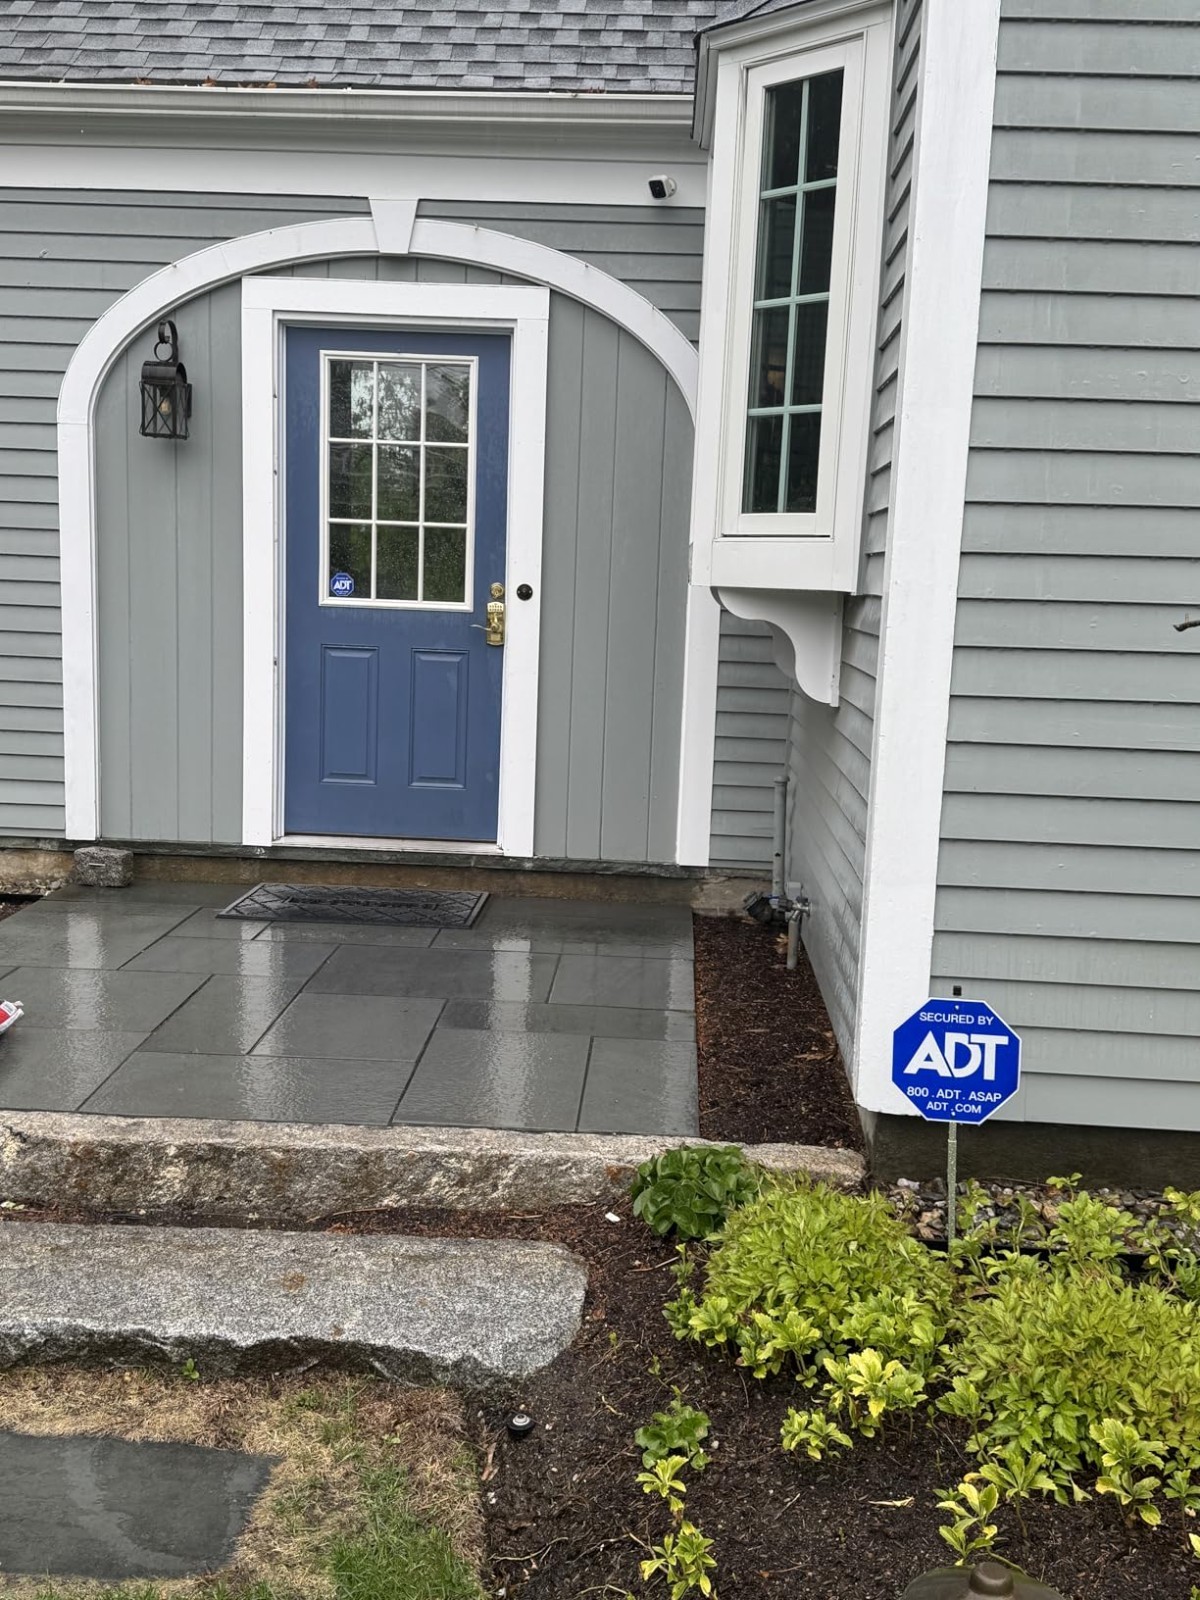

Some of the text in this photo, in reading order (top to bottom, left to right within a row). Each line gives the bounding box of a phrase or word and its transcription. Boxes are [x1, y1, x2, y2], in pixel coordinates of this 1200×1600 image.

[333, 580, 352, 590] ADT
[919, 1012, 994, 1026] SECURED BY
[903, 1030, 1009, 1081] ADT
